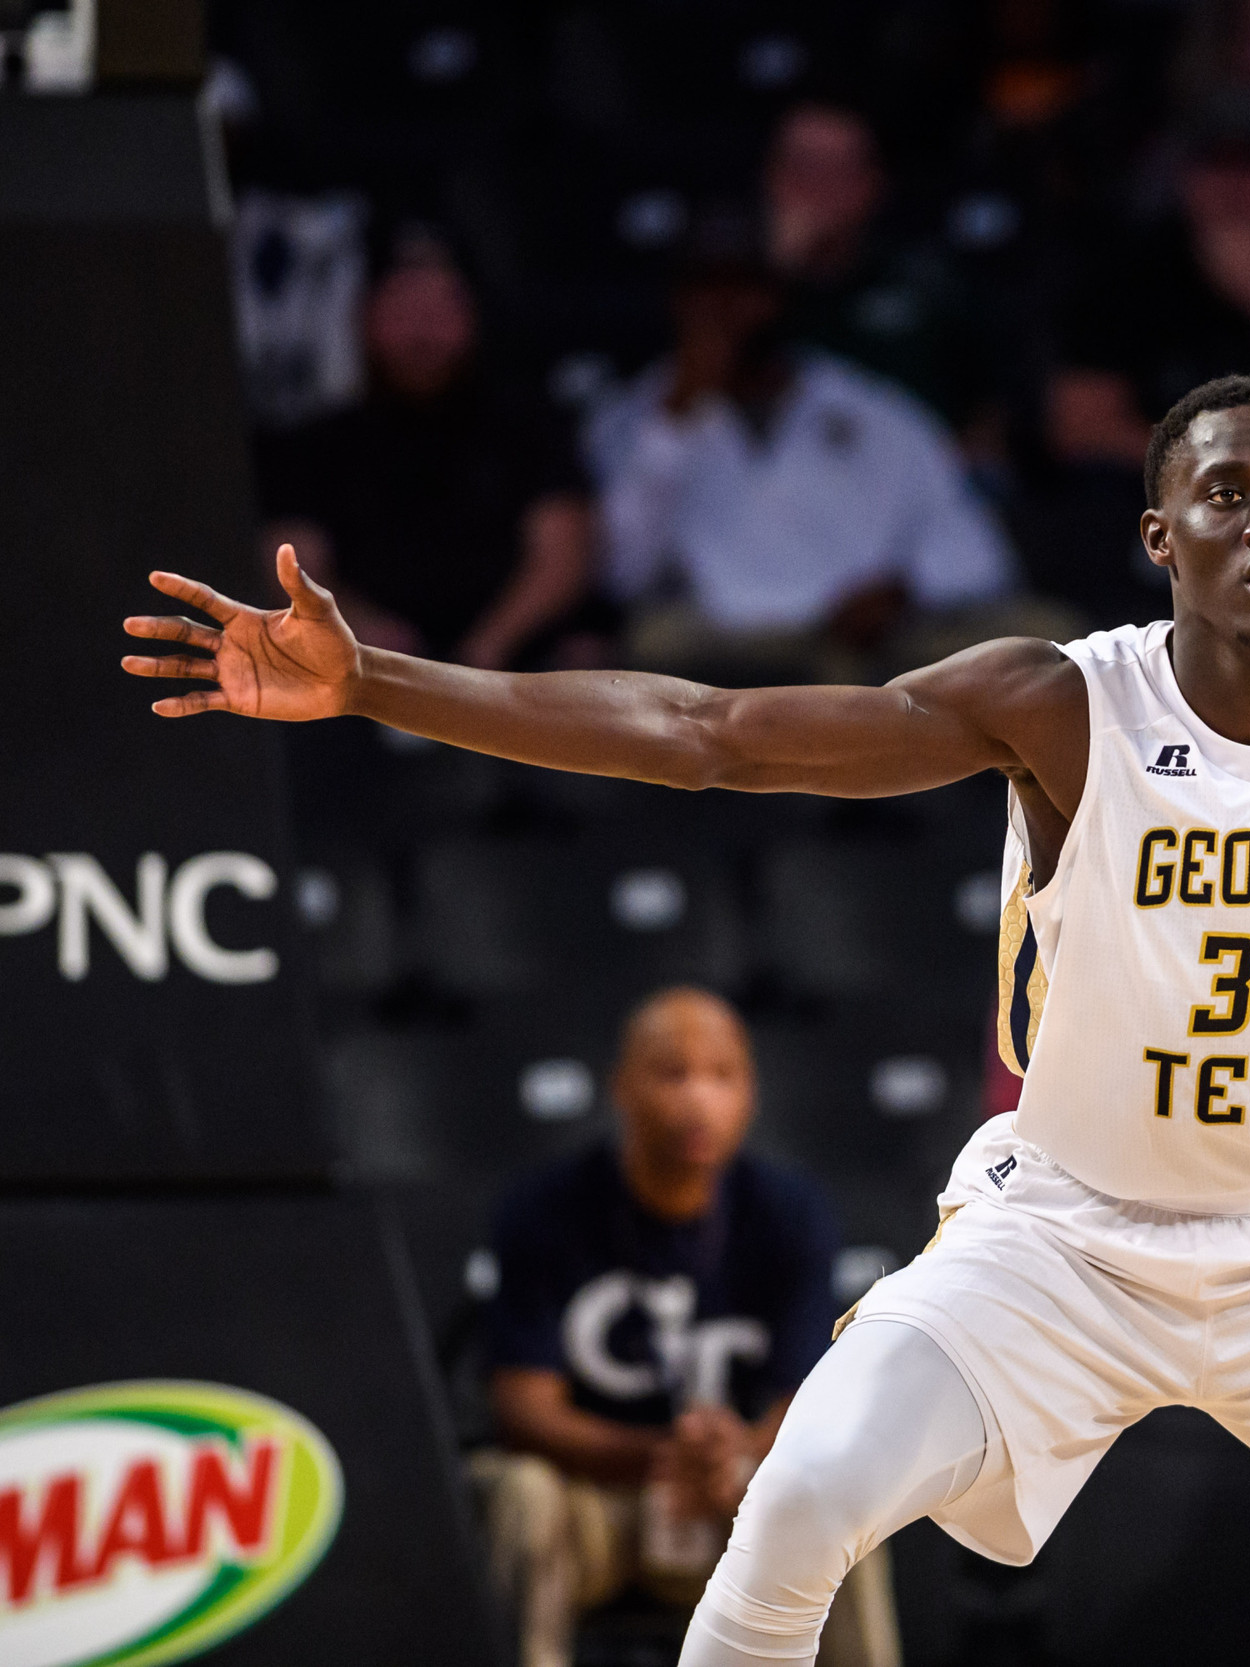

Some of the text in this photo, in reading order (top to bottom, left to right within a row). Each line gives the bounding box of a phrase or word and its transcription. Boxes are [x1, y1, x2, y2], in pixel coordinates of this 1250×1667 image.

[1155, 744, 1191, 768] R
[1145, 765, 1198, 777] RUSSELL
[0, 850, 281, 984] PNC
[995, 1154, 1017, 1179] R
[985, 1167, 1005, 1191] RUSSELL
